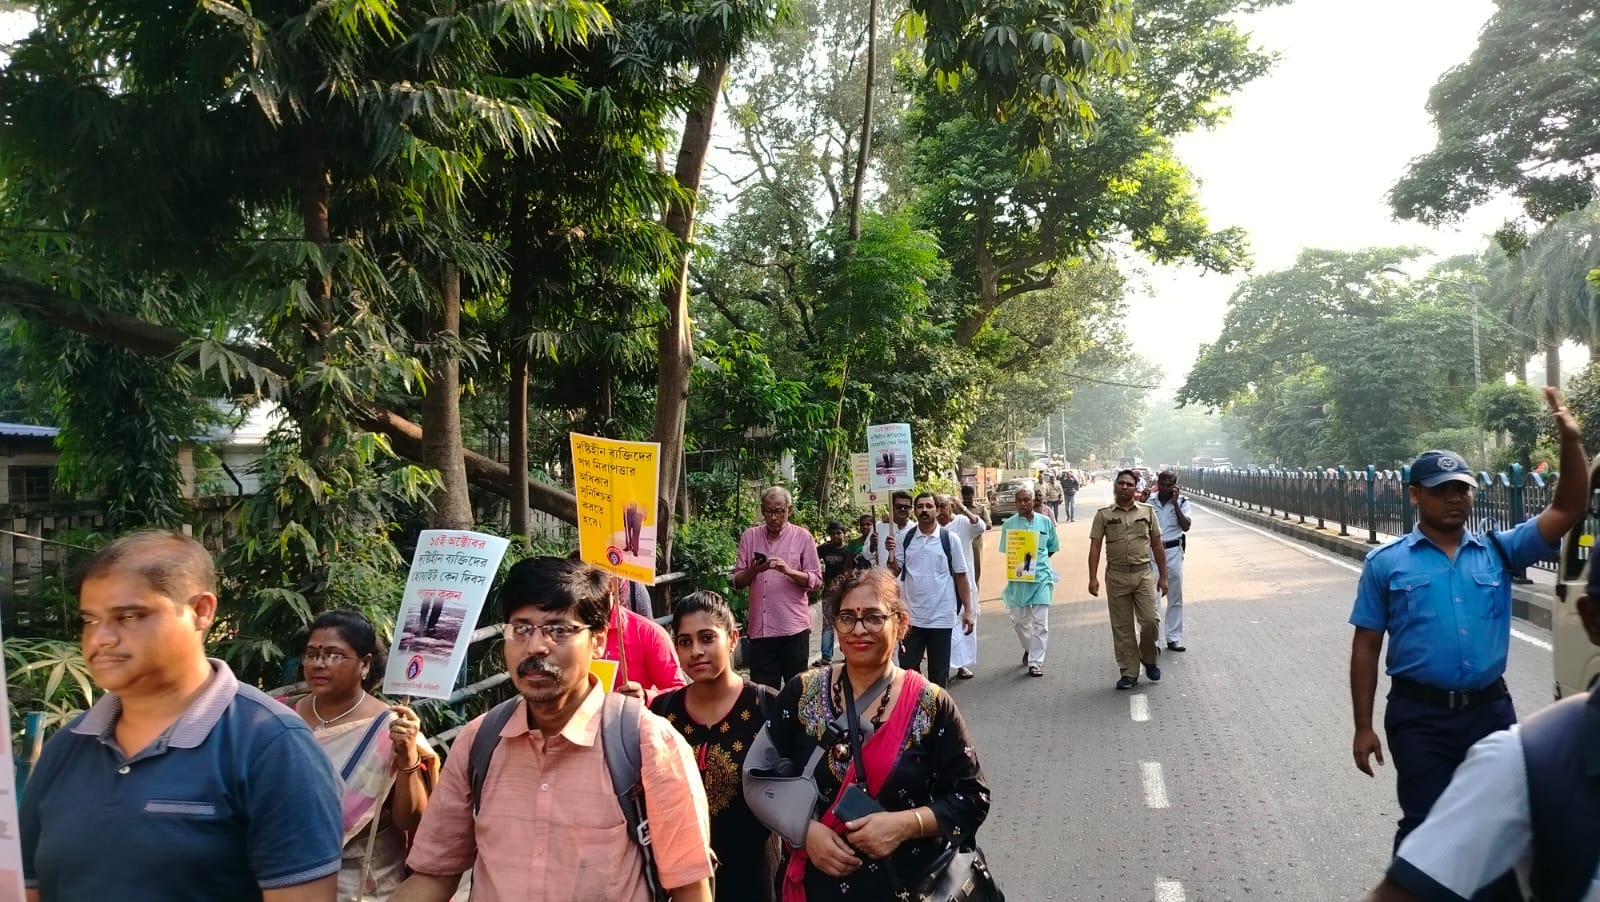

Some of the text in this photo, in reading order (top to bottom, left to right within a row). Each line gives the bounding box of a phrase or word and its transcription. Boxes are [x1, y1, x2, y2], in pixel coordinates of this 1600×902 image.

[608, 446, 653, 462] ব্যক্তিদের
[592, 458, 636, 476] নিরাপত্তার
[448, 534, 487, 549] অক্টোবর
[445, 551, 488, 568] ব্যক্তিদের
[440, 571, 459, 583] কেন
[460, 570, 486, 586] দিবস
